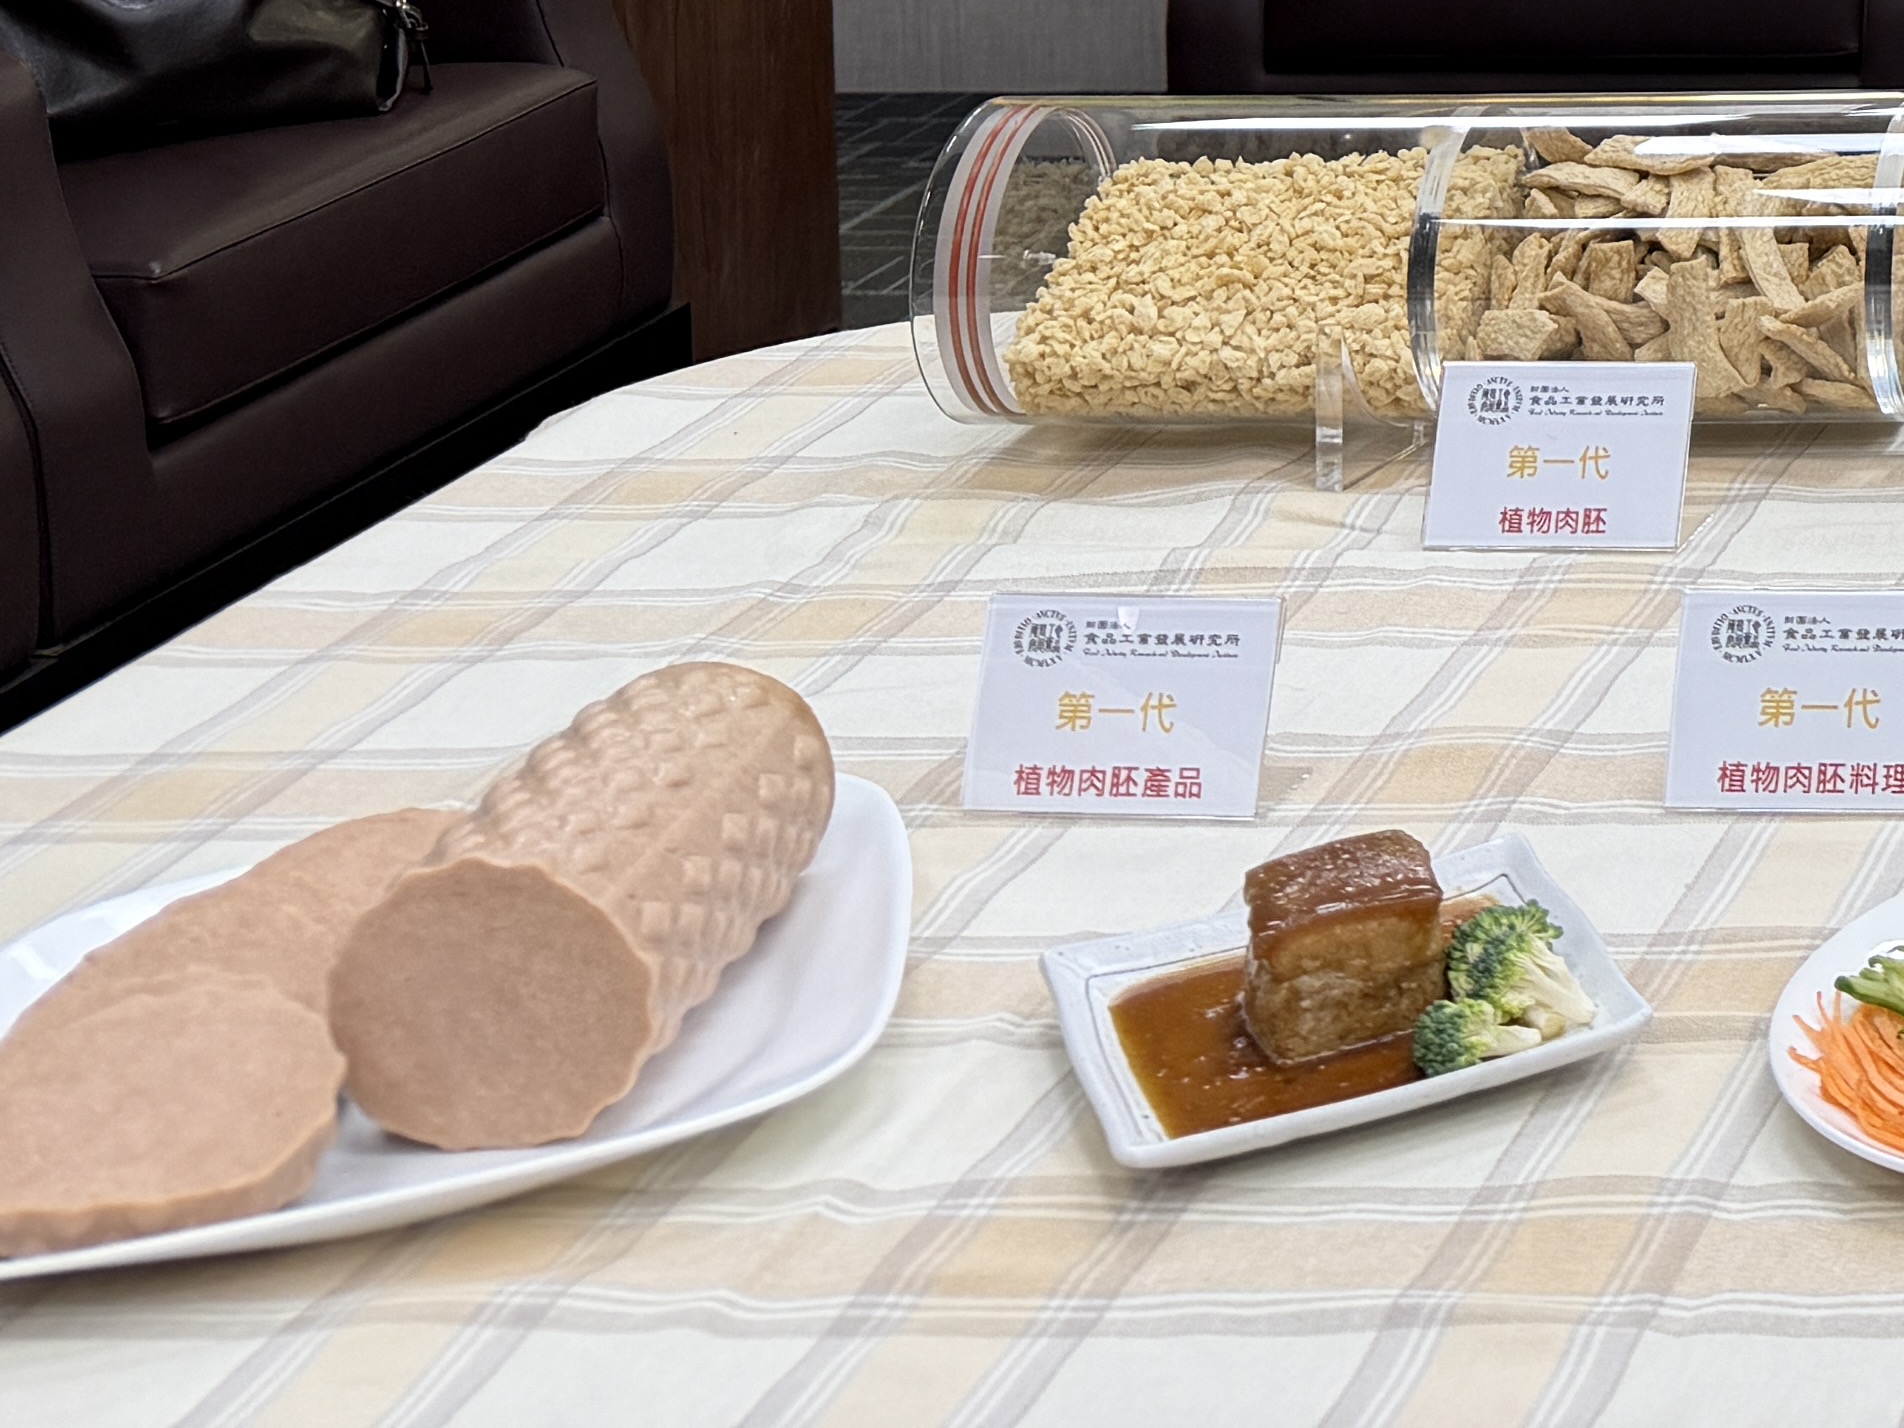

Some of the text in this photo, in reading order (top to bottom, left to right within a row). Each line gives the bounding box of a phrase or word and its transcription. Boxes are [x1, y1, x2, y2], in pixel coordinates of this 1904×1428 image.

[1506, 445, 1611, 480] 第一代
[1498, 506, 1608, 535] 植物肉胚
[1055, 691, 1177, 734] 第一代
[1757, 687, 1881, 730] 第一代
[1012, 763, 1202, 799] 植物肉胚產品
